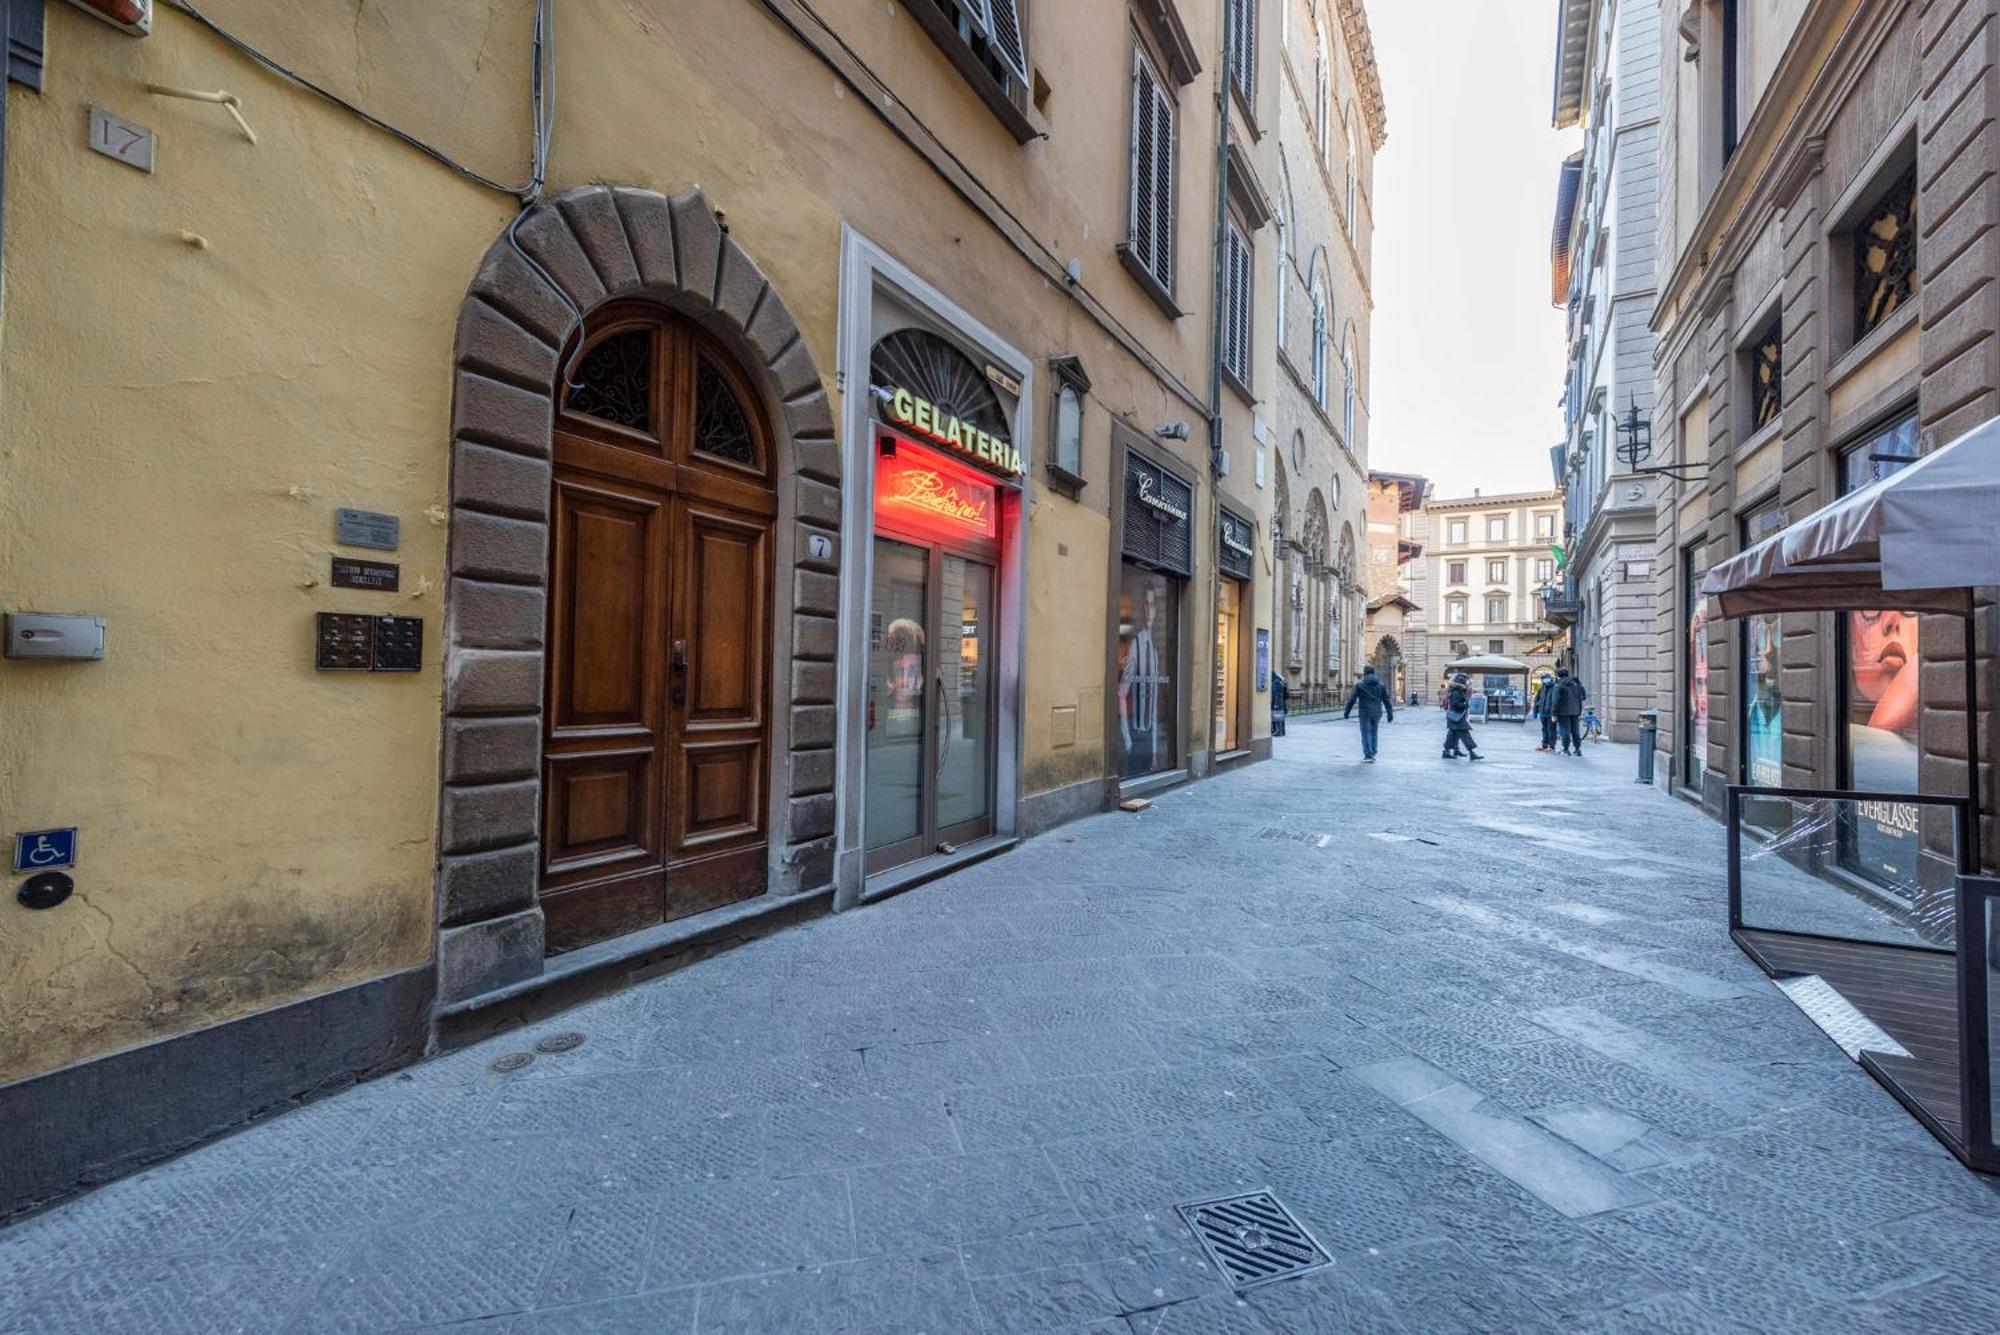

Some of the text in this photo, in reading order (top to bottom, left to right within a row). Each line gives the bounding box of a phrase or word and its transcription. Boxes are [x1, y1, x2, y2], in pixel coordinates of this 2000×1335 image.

[102, 119, 144, 154] 17
[894, 388, 1022, 475] GELATERIA
[817, 538, 825, 556] 7
